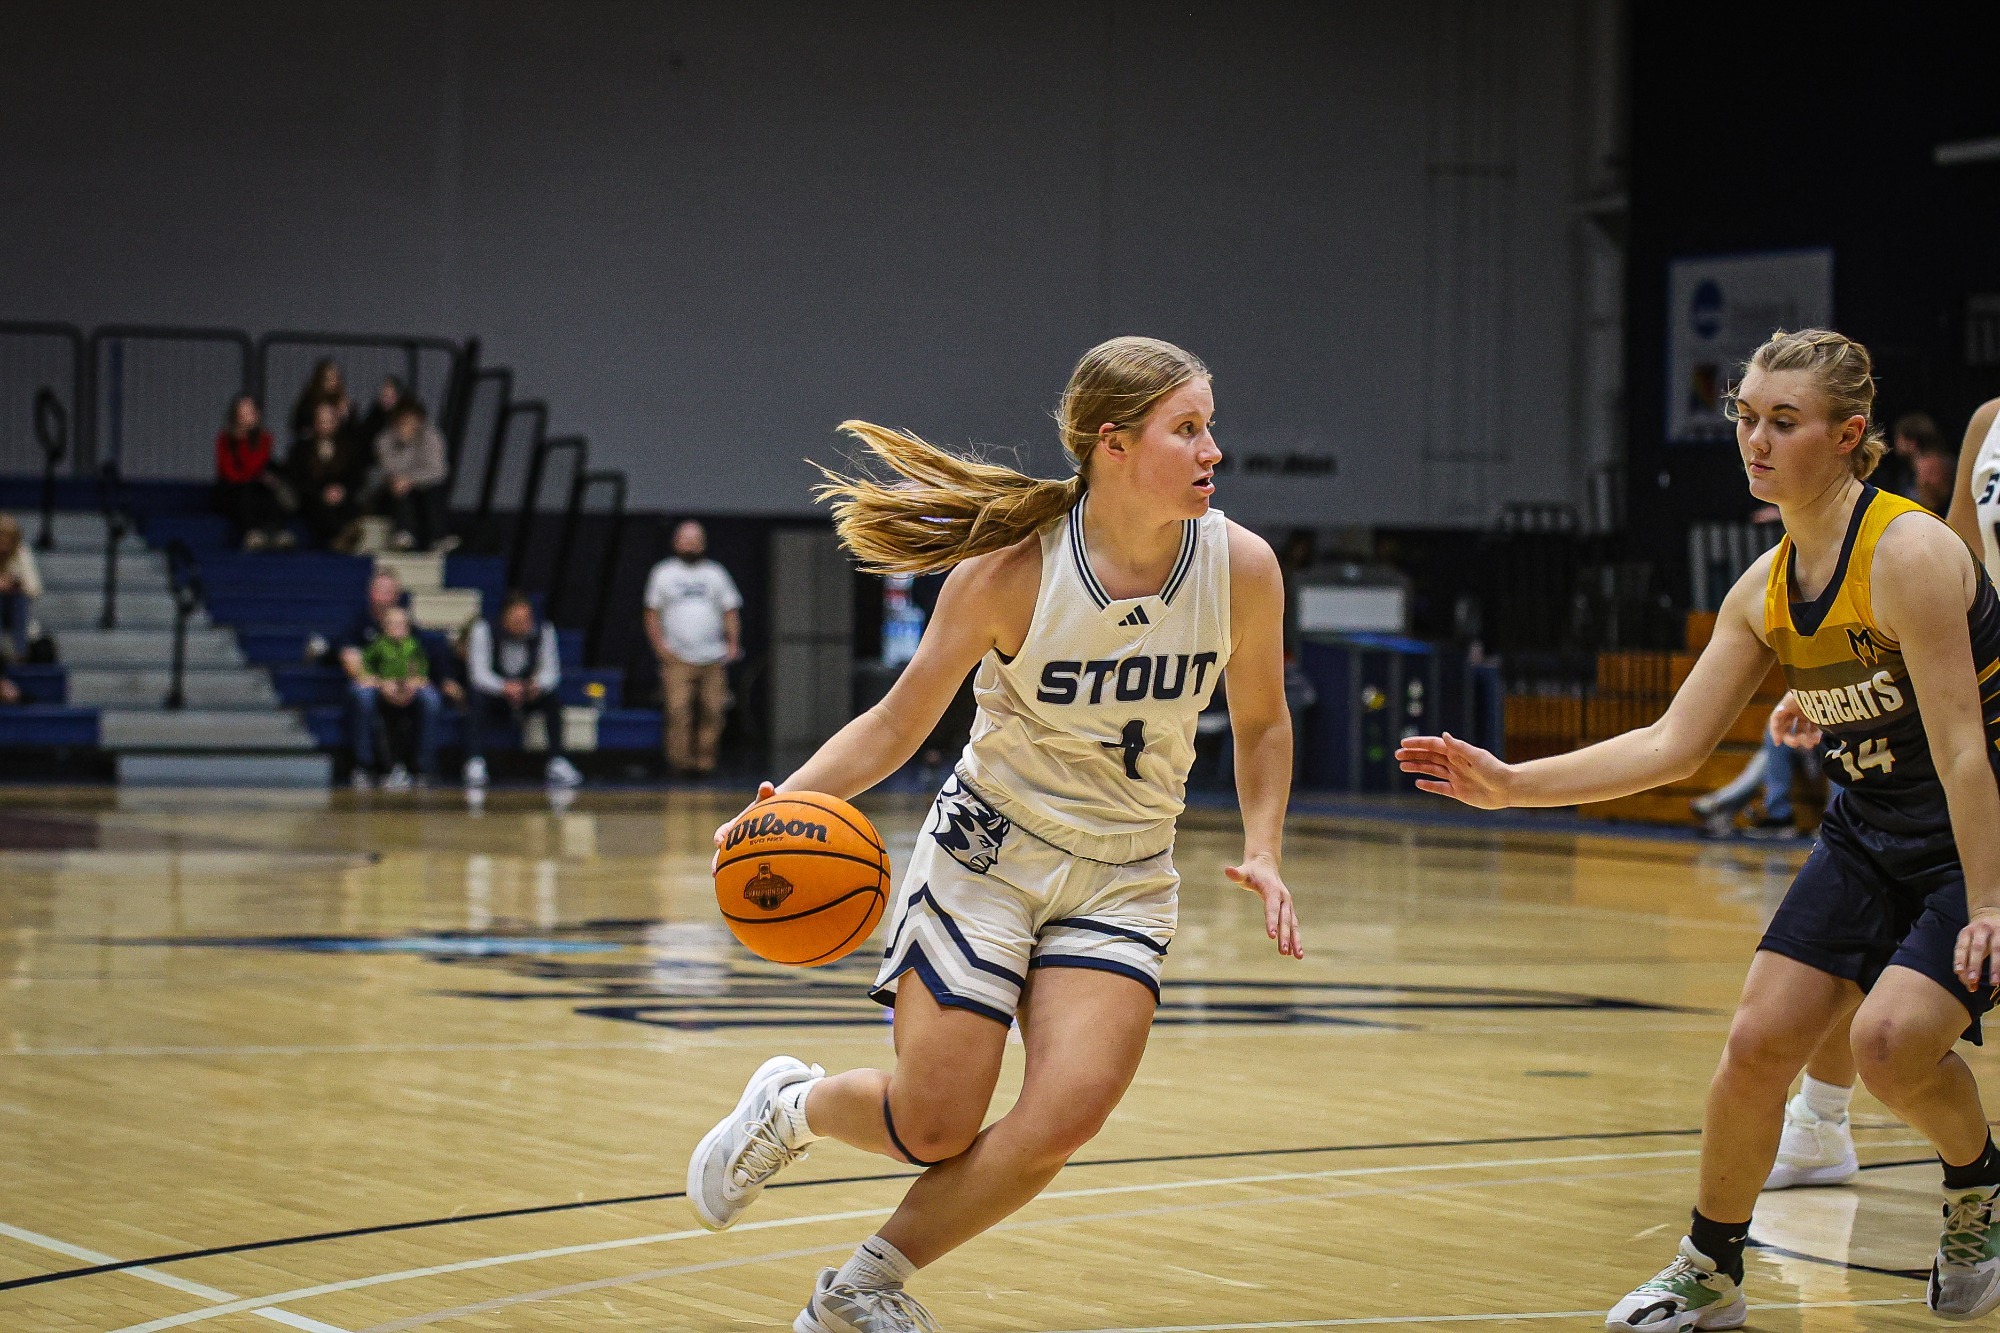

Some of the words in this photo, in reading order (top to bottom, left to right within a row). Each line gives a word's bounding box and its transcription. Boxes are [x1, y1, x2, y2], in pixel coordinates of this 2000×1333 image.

[1844, 627, 1879, 668] M
[1037, 652, 1218, 705] STOUT
[1824, 737, 1896, 782] 14
[726, 812, 827, 851] Wilson
